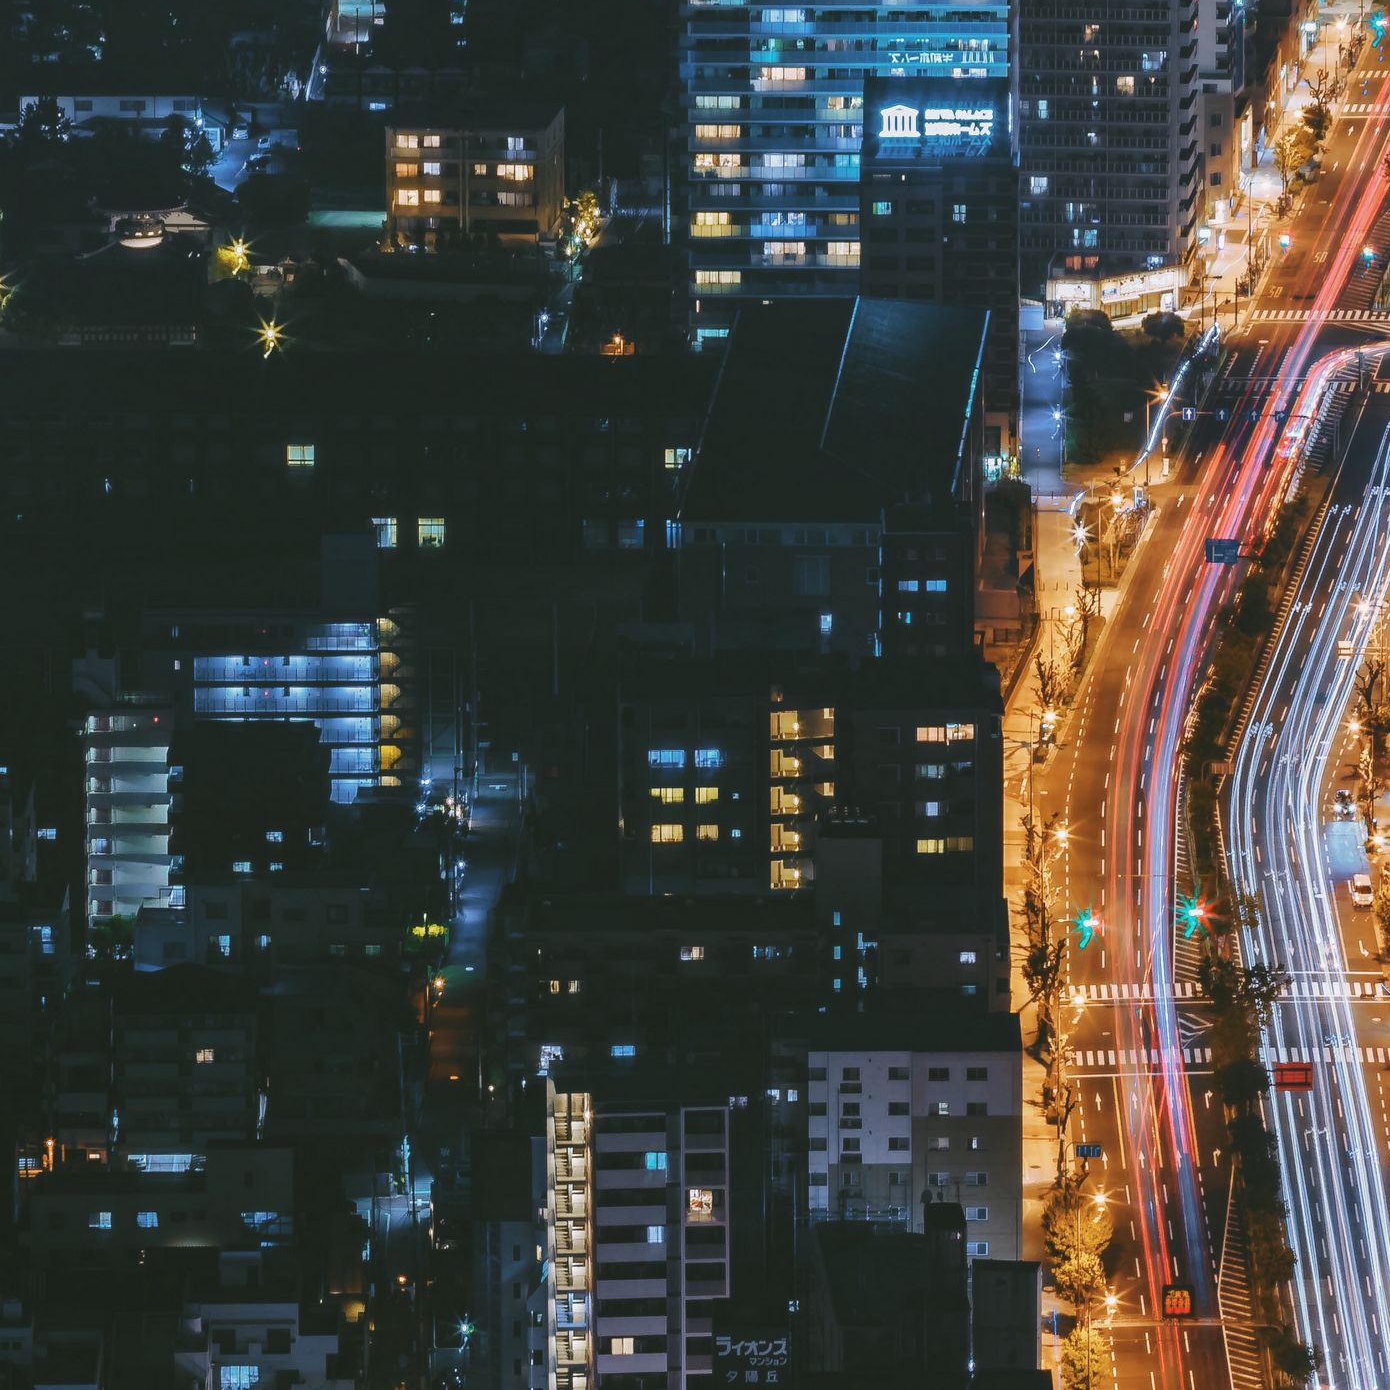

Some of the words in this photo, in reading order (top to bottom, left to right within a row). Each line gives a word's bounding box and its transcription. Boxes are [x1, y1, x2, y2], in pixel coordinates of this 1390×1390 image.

[1313, 251, 1328, 263] 50
[1267, 286, 1283, 298] 50
[716, 1336, 787, 1356] ライオンズ
[749, 1357, 788, 1366] マンション
[726, 1370, 778, 1383] 夕陽丘
